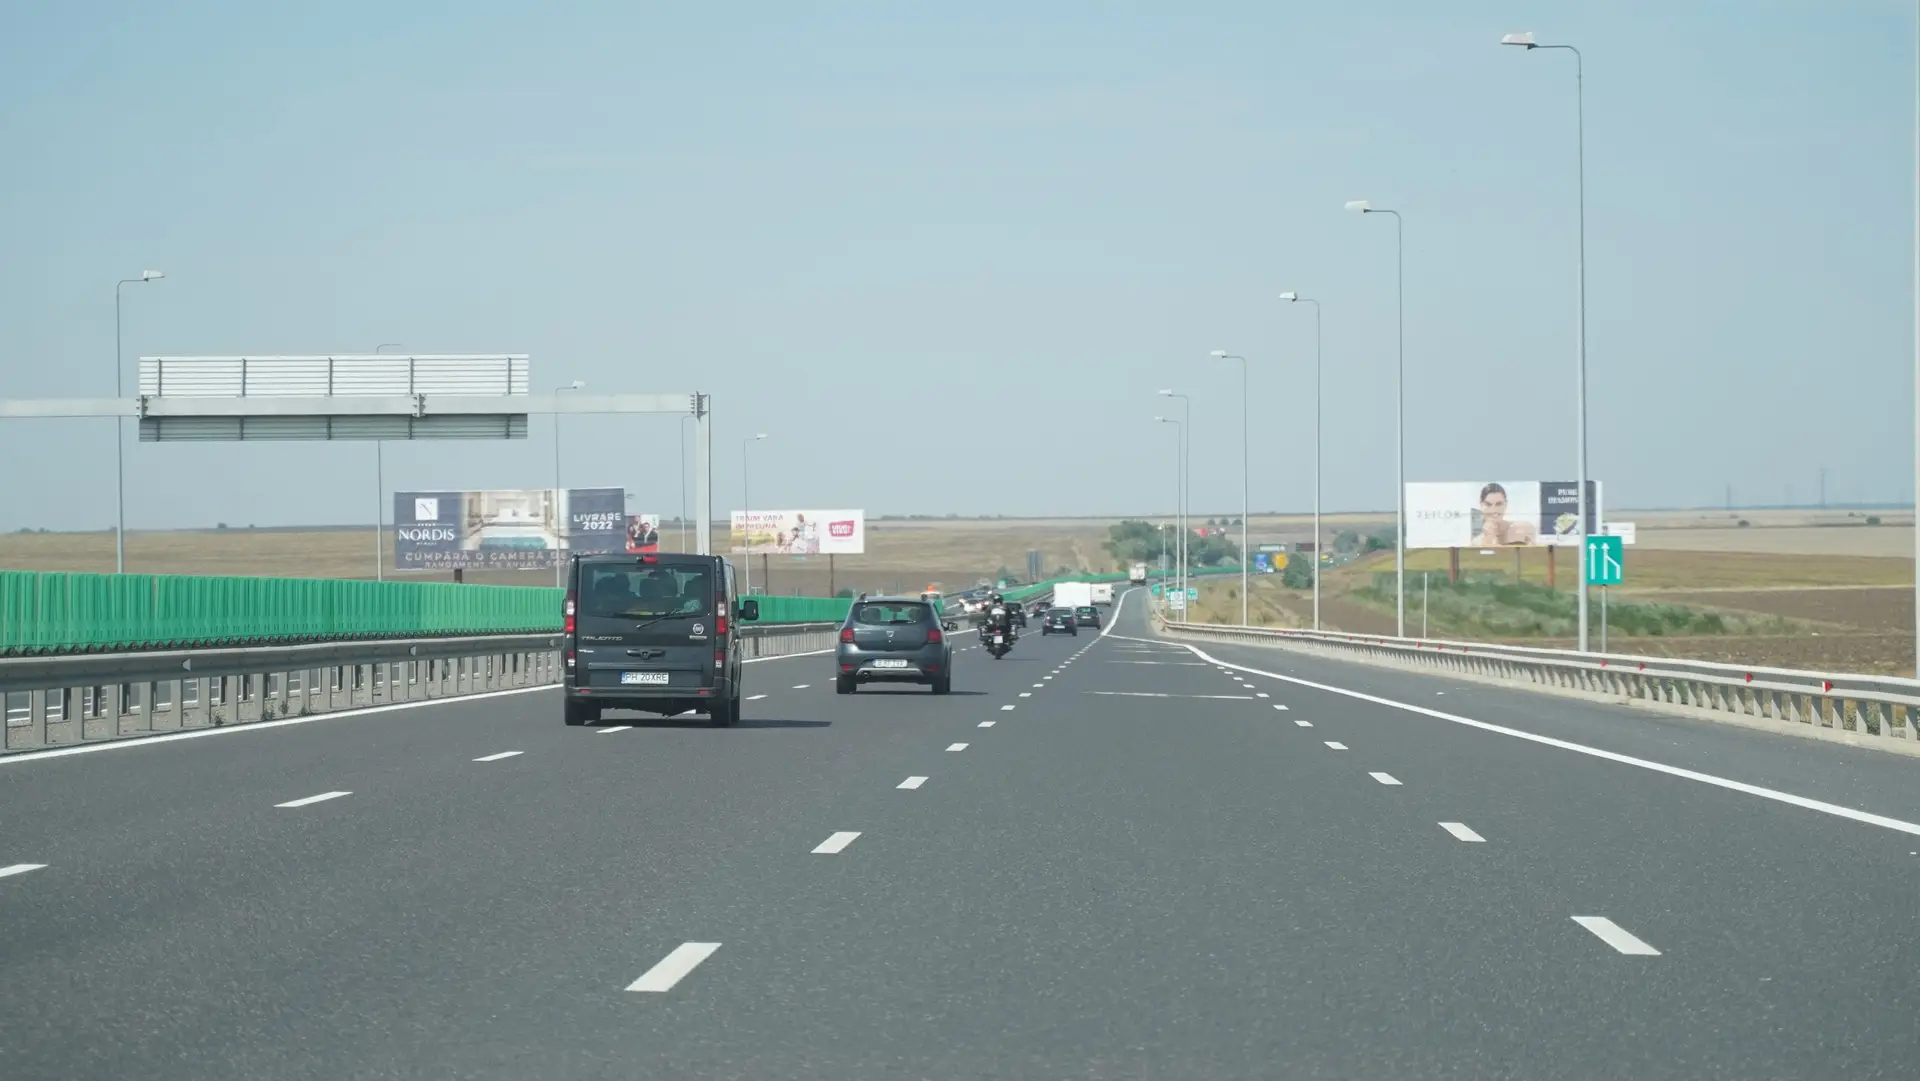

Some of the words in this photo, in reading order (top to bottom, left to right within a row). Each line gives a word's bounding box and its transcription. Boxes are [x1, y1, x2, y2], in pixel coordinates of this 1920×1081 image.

[573, 512, 622, 522] LIVRARE
[582, 521, 613, 530] 2022
[398, 528, 456, 541] NORDIS
[625, 673, 638, 681] PH
